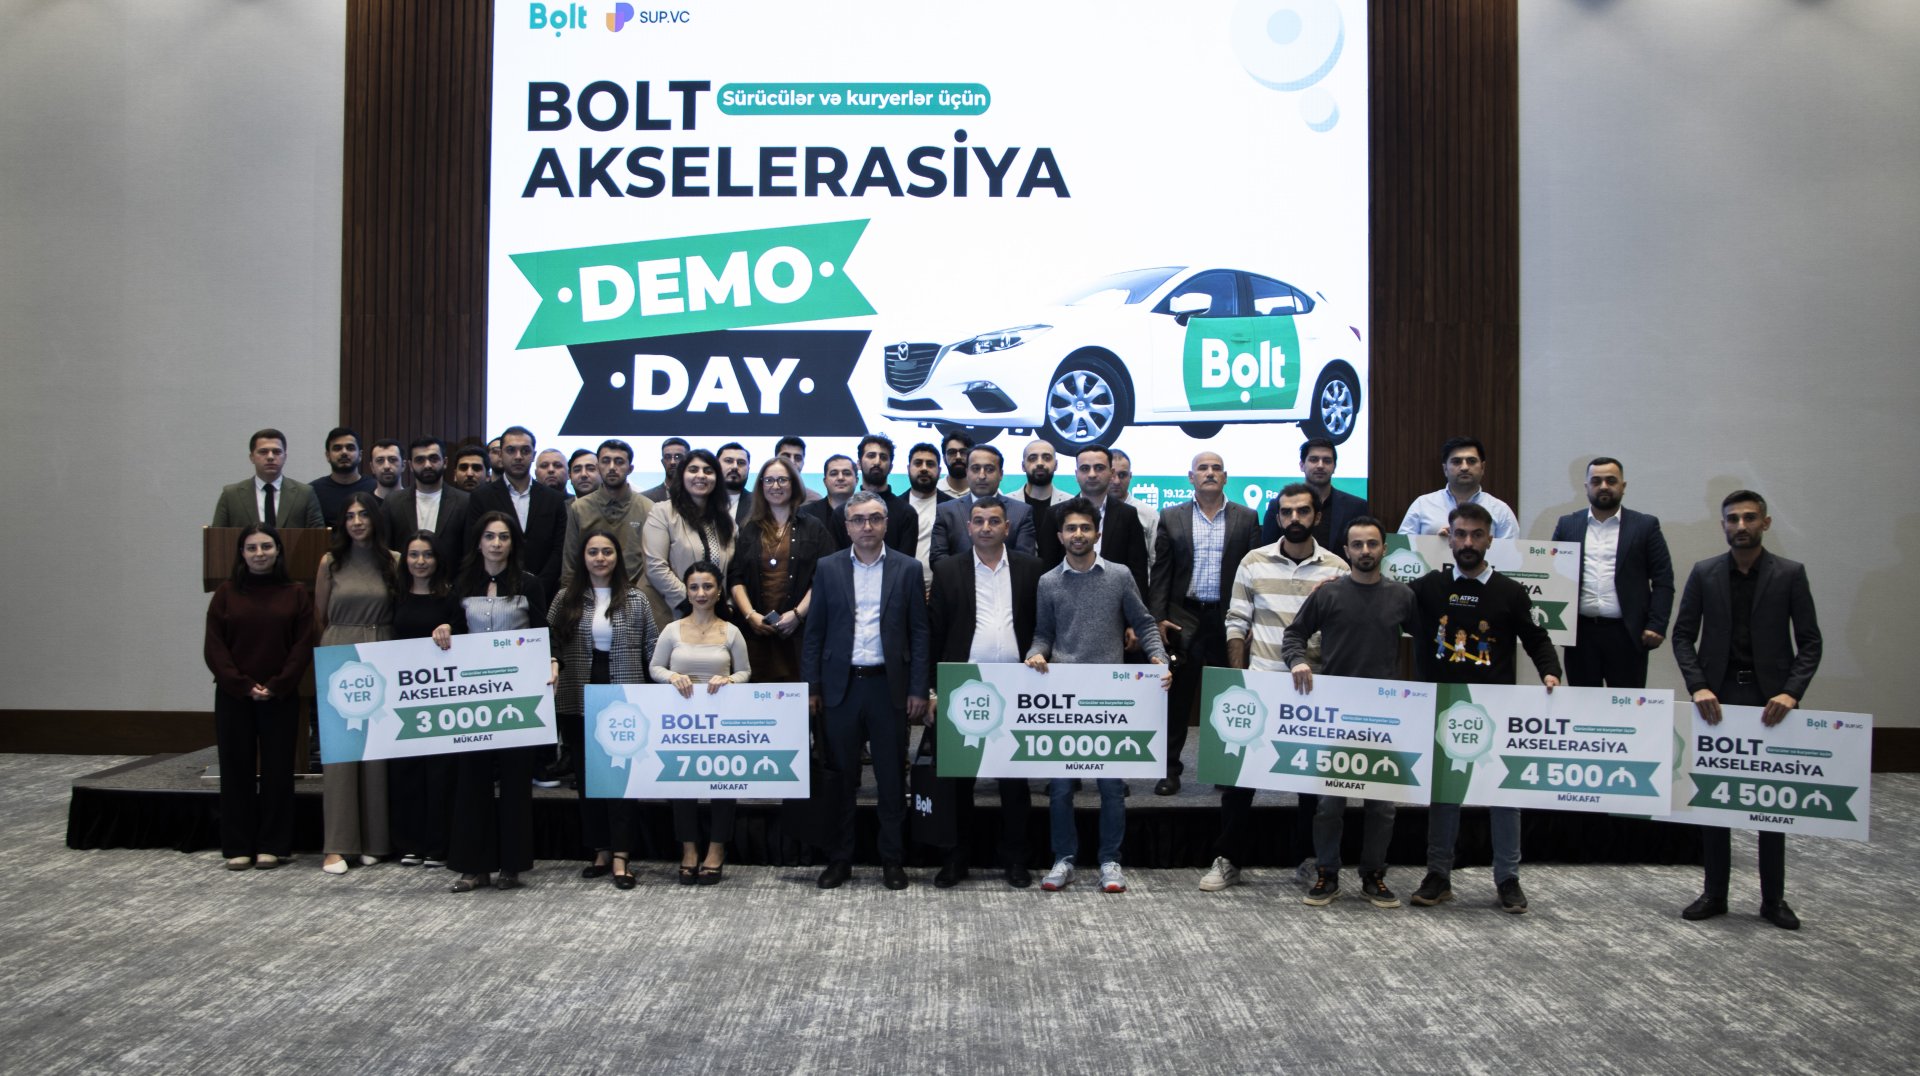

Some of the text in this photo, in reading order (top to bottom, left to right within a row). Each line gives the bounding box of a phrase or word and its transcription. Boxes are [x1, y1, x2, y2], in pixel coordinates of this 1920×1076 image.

[529, 3, 587, 37] Bolt
[640, 10, 690, 24] SUP.VC
[527, 80, 711, 131] BOLT
[722, 89, 986, 111] Sürücülər və kuryerlər üçün
[521, 129, 1071, 198] AKSELERASİYA
[578, 246, 814, 323] DEMO
[1201, 338, 1286, 403] Bolt
[632, 355, 801, 415] DAY
[1529, 547, 1546, 557] Bolt
[1389, 563, 1421, 575] 4-CÜ
[494, 638, 511, 648] Bolt
[339, 675, 374, 690] 4-CÜ
[398, 666, 458, 686] BOLT
[1112, 671, 1130, 681] Bolt
[344, 692, 371, 702] YER
[399, 680, 513, 701] AKSELERASİYA
[754, 691, 771, 701] Bolt
[1378, 687, 1396, 699] Bolt
[963, 694, 990, 707] 1-Cİ
[1017, 694, 1076, 709] BOLT
[1612, 696, 1631, 706] Bolt
[964, 710, 989, 720] YER
[1222, 703, 1256, 716] 3-CÜ
[1279, 704, 1339, 724] BOLT
[416, 710, 432, 732] 3
[439, 705, 492, 730] 000
[609, 716, 636, 728] 2-Cİ
[662, 714, 718, 730] BOLT
[1016, 710, 1128, 724] AKSELERASİYA
[1226, 717, 1251, 728] YER
[1448, 718, 1483, 730] 3-CÜ
[1807, 718, 1827, 730] Bolt
[1508, 717, 1570, 735] BOLT
[453, 734, 494, 744] MÜKAFAT
[611, 731, 635, 741] YER
[661, 730, 770, 744] AKSELERASİYA
[1278, 724, 1392, 744] AKSELERASİYA
[1453, 732, 1478, 744] YER
[1025, 735, 1052, 756] 10
[1059, 735, 1111, 756] 000
[1506, 738, 1628, 754] AKSELERASİYA
[1698, 735, 1763, 755] BOLT
[676, 756, 691, 776] 7
[696, 755, 747, 776] 000
[1066, 762, 1104, 770] MÜKAFAT
[1290, 749, 1308, 770] 4
[1316, 750, 1368, 775] 500
[1696, 757, 1824, 777] AKSELERASİYA
[1520, 762, 1540, 785] 4
[1547, 764, 1603, 788] 500
[710, 782, 748, 790] MÜKAFAT
[1326, 779, 1365, 790] MÜKAFAT
[1558, 792, 1600, 803] MÜKAFAT
[1711, 781, 1731, 804] 4
[1739, 783, 1797, 809] 500
[916, 794, 933, 816] Bolt
[1749, 812, 1795, 824] MÜKAFAT
